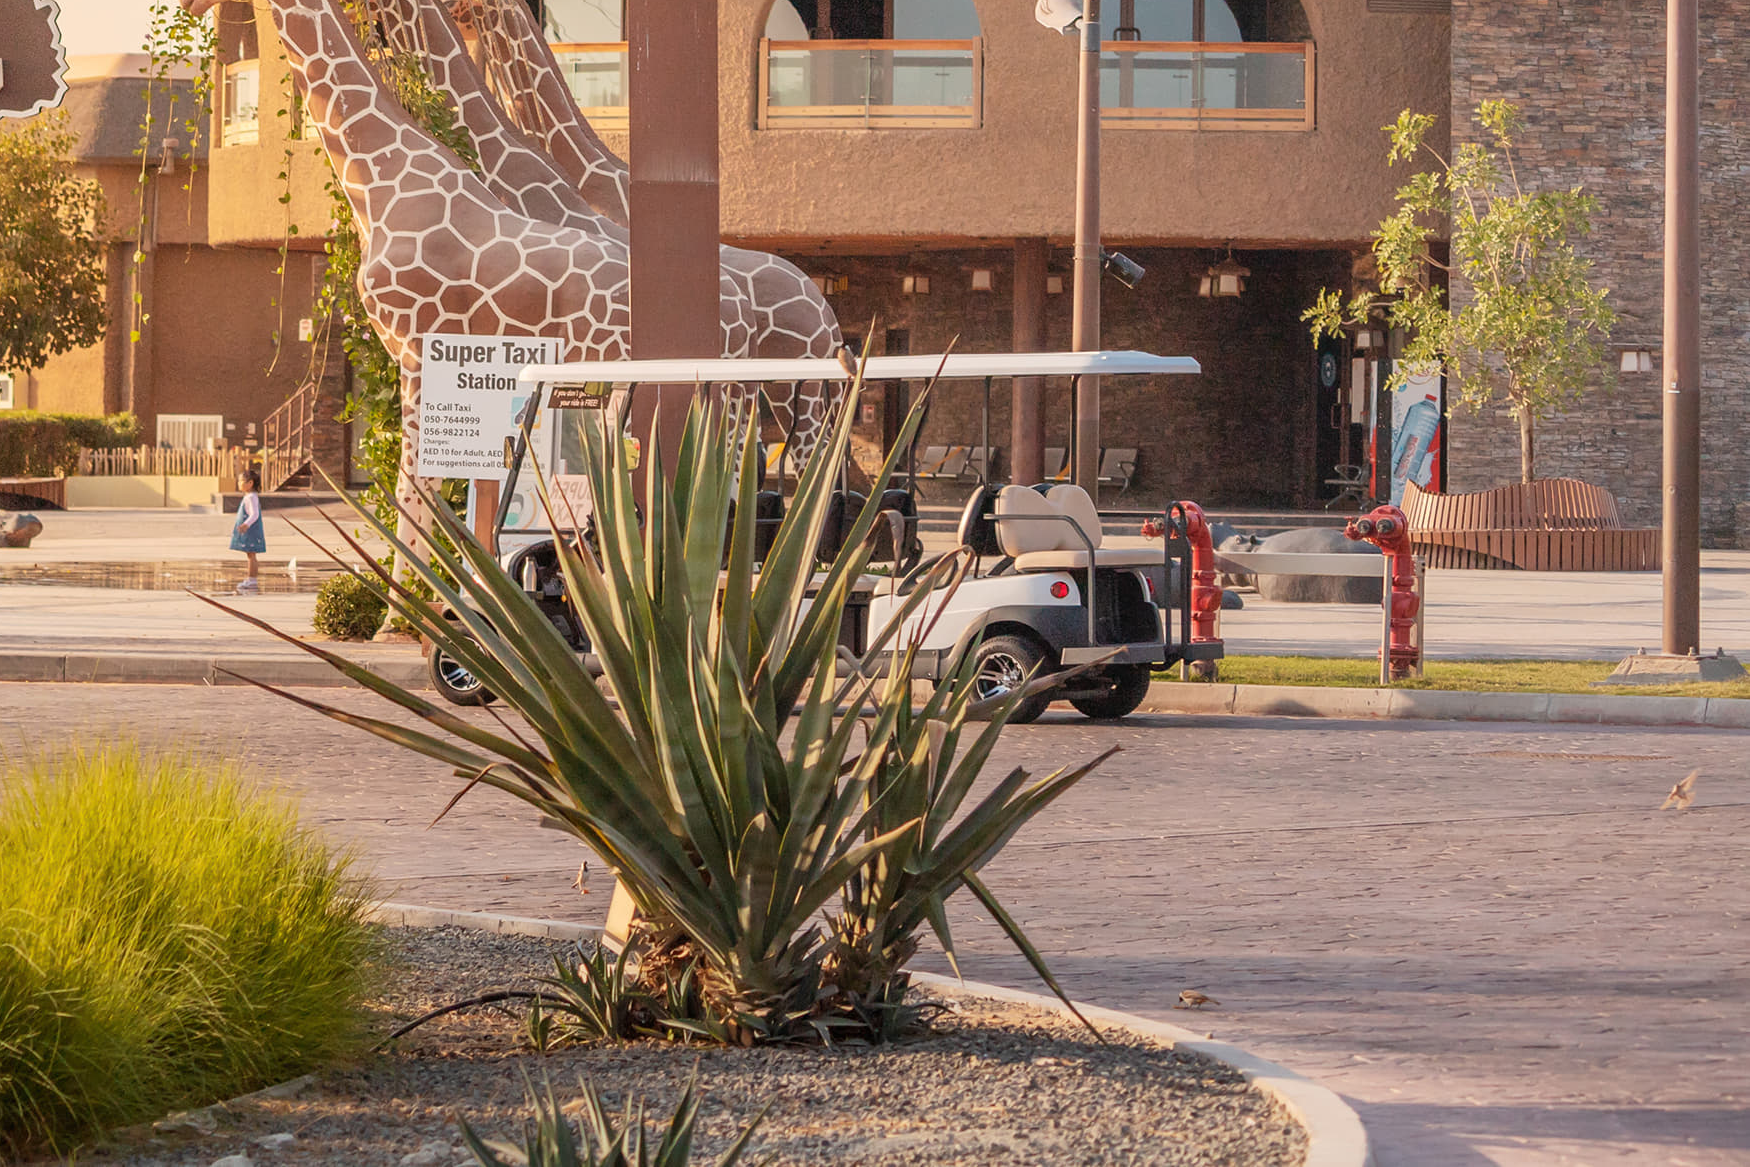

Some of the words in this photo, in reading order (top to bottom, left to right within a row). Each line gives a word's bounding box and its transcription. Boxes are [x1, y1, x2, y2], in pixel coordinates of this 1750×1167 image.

[431, 340, 496, 367] Super
[502, 342, 546, 365] Taxi
[457, 372, 516, 390] Station
[425, 403, 435, 411] To
[436, 403, 453, 411] Call
[454, 403, 472, 412] Taxi
[424, 415, 481, 425] 050-7644999
[423, 427, 480, 437] 056-9822124
[451, 448, 462, 456] for
[487, 450, 503, 458] AED
[422, 458, 435, 466] For
[436, 458, 481, 469] suggestions
[482, 460, 495, 468] call
